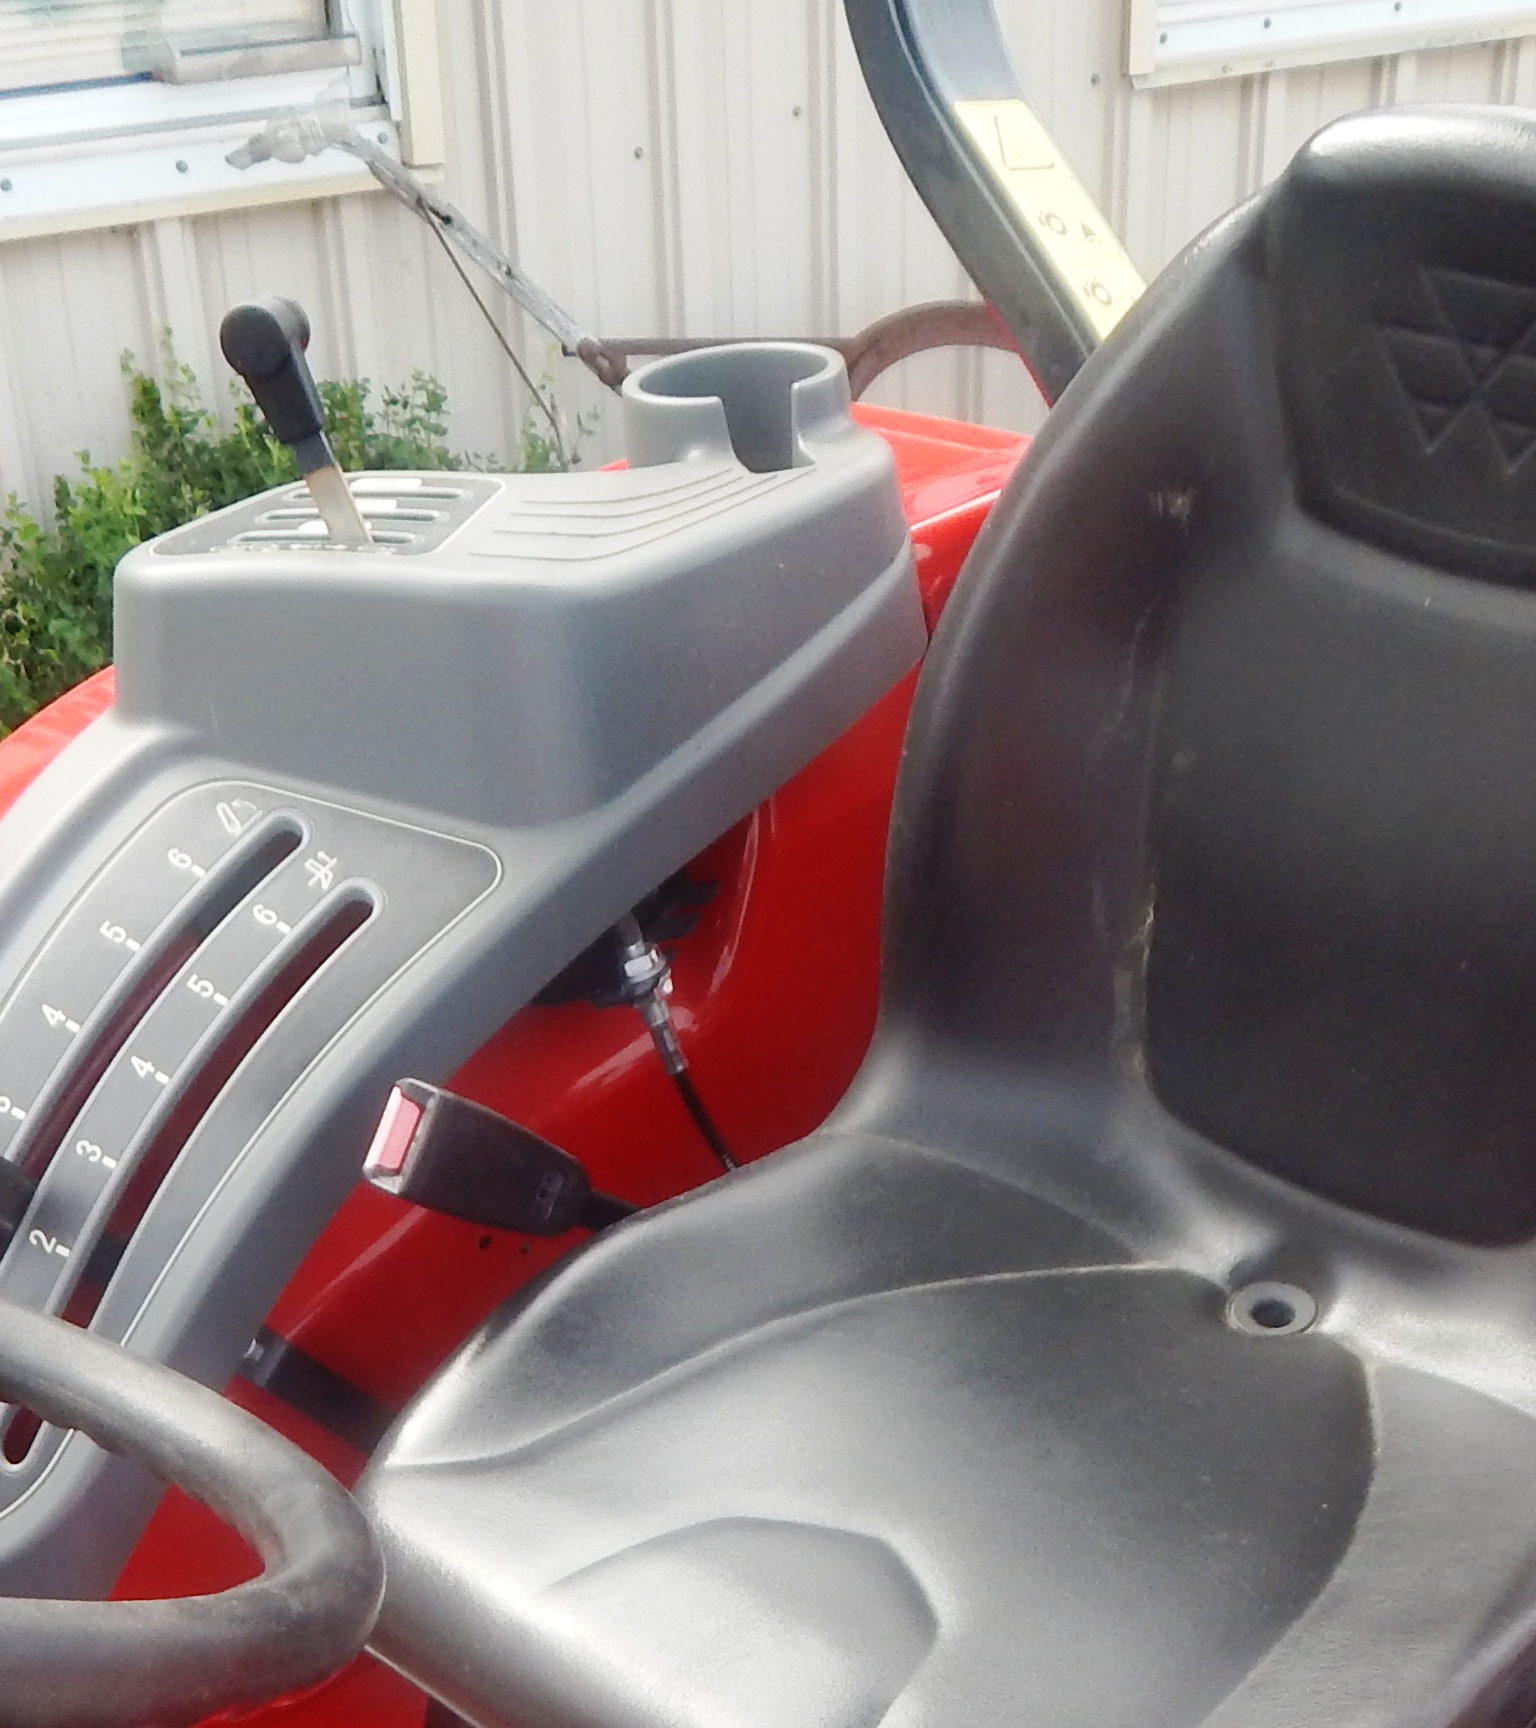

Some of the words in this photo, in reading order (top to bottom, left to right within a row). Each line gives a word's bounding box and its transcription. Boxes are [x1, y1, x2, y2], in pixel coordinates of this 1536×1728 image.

[167, 846, 195, 869] 6
[252, 904, 279, 930] 6
[100, 920, 129, 945] 5
[186, 973, 215, 998] 5
[41, 1003, 67, 1029] 4
[130, 1055, 156, 1079] 4
[75, 1139, 103, 1163] 3
[29, 1229, 57, 1253] 2
